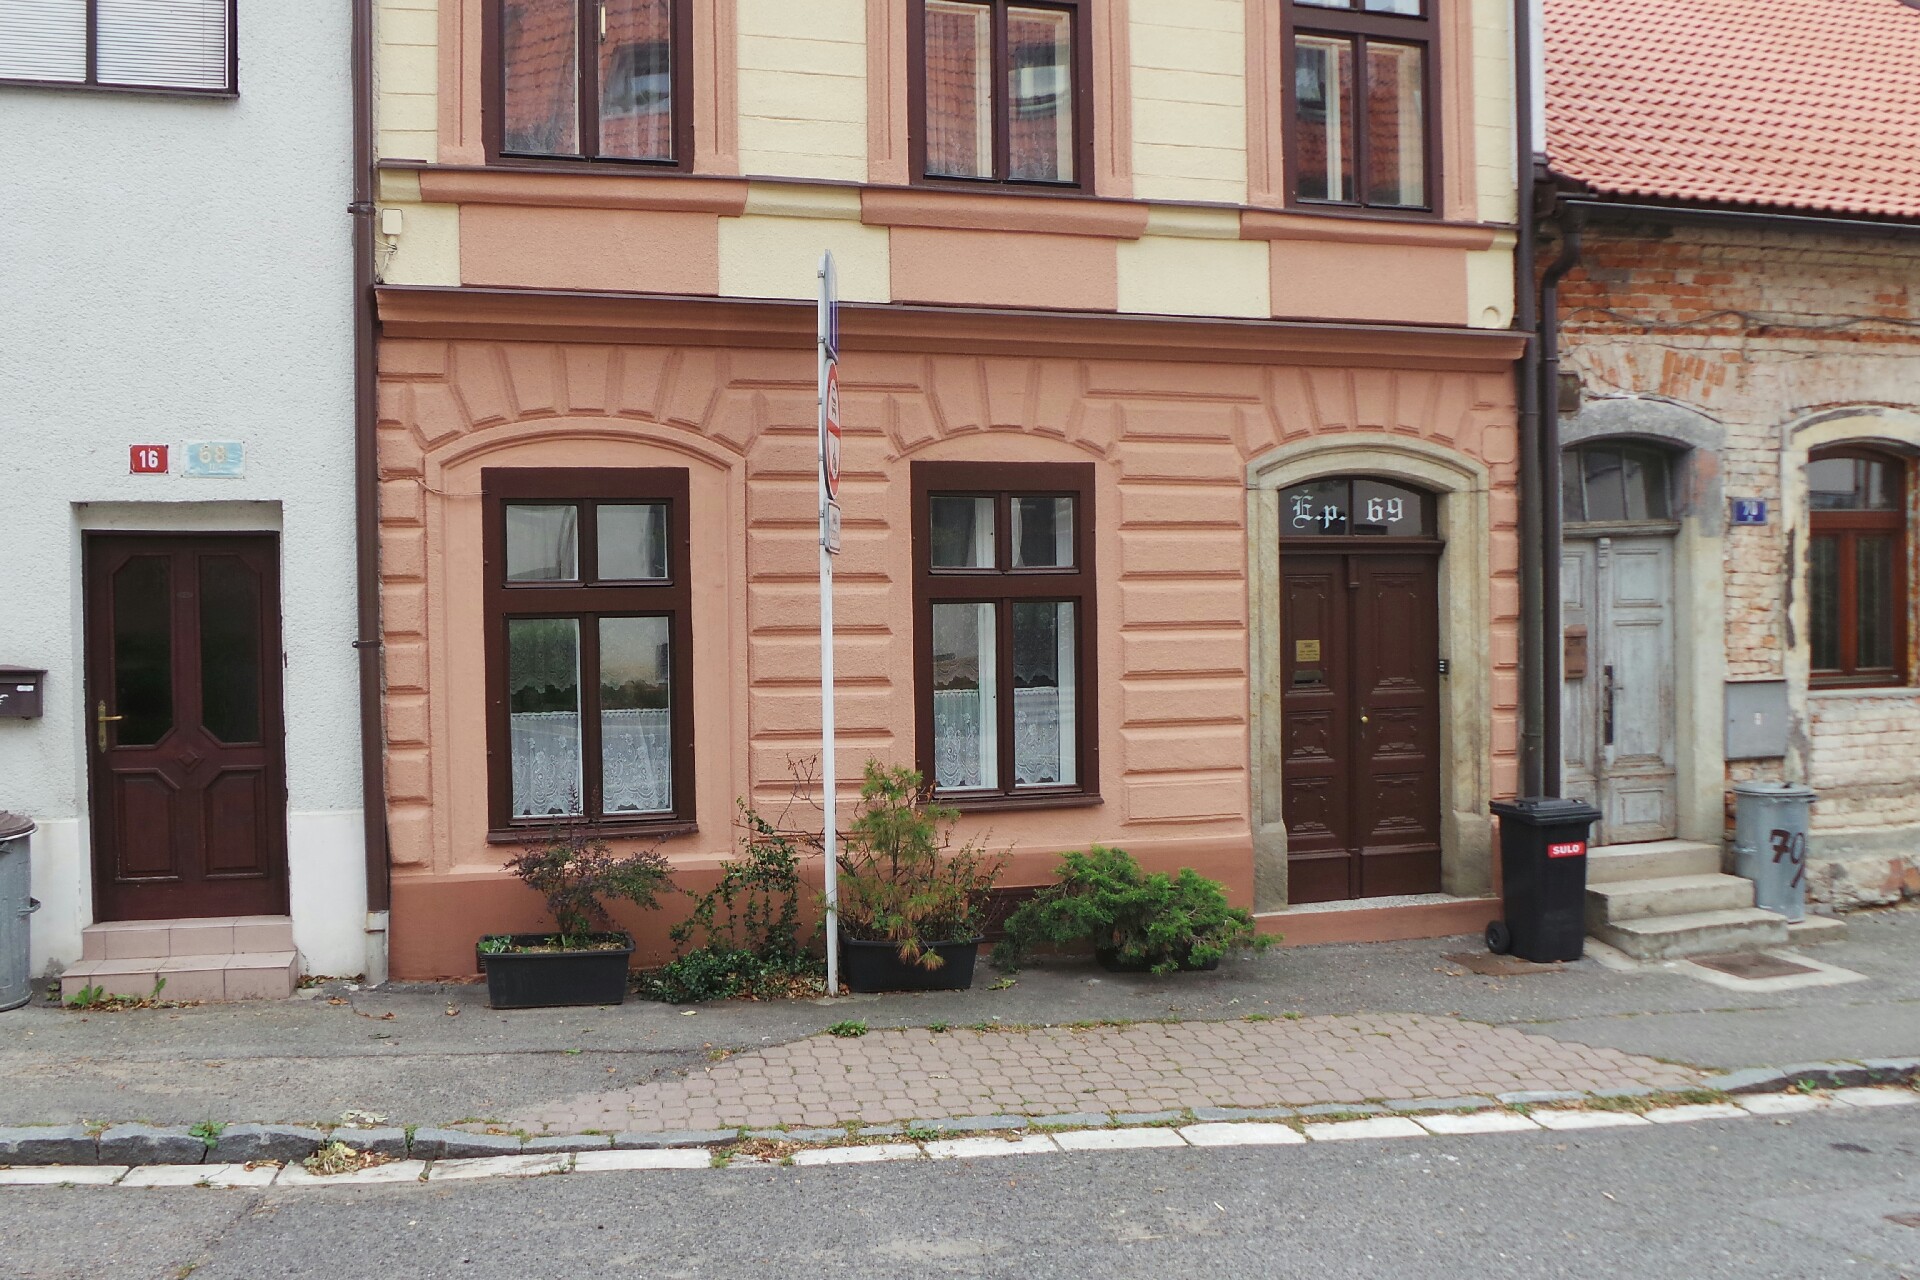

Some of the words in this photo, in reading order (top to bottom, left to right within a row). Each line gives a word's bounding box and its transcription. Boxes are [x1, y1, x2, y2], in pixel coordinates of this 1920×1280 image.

[139, 450, 158, 468] 16
[1366, 497, 1404, 523] 69
[1552, 844, 1580, 855] SULO
